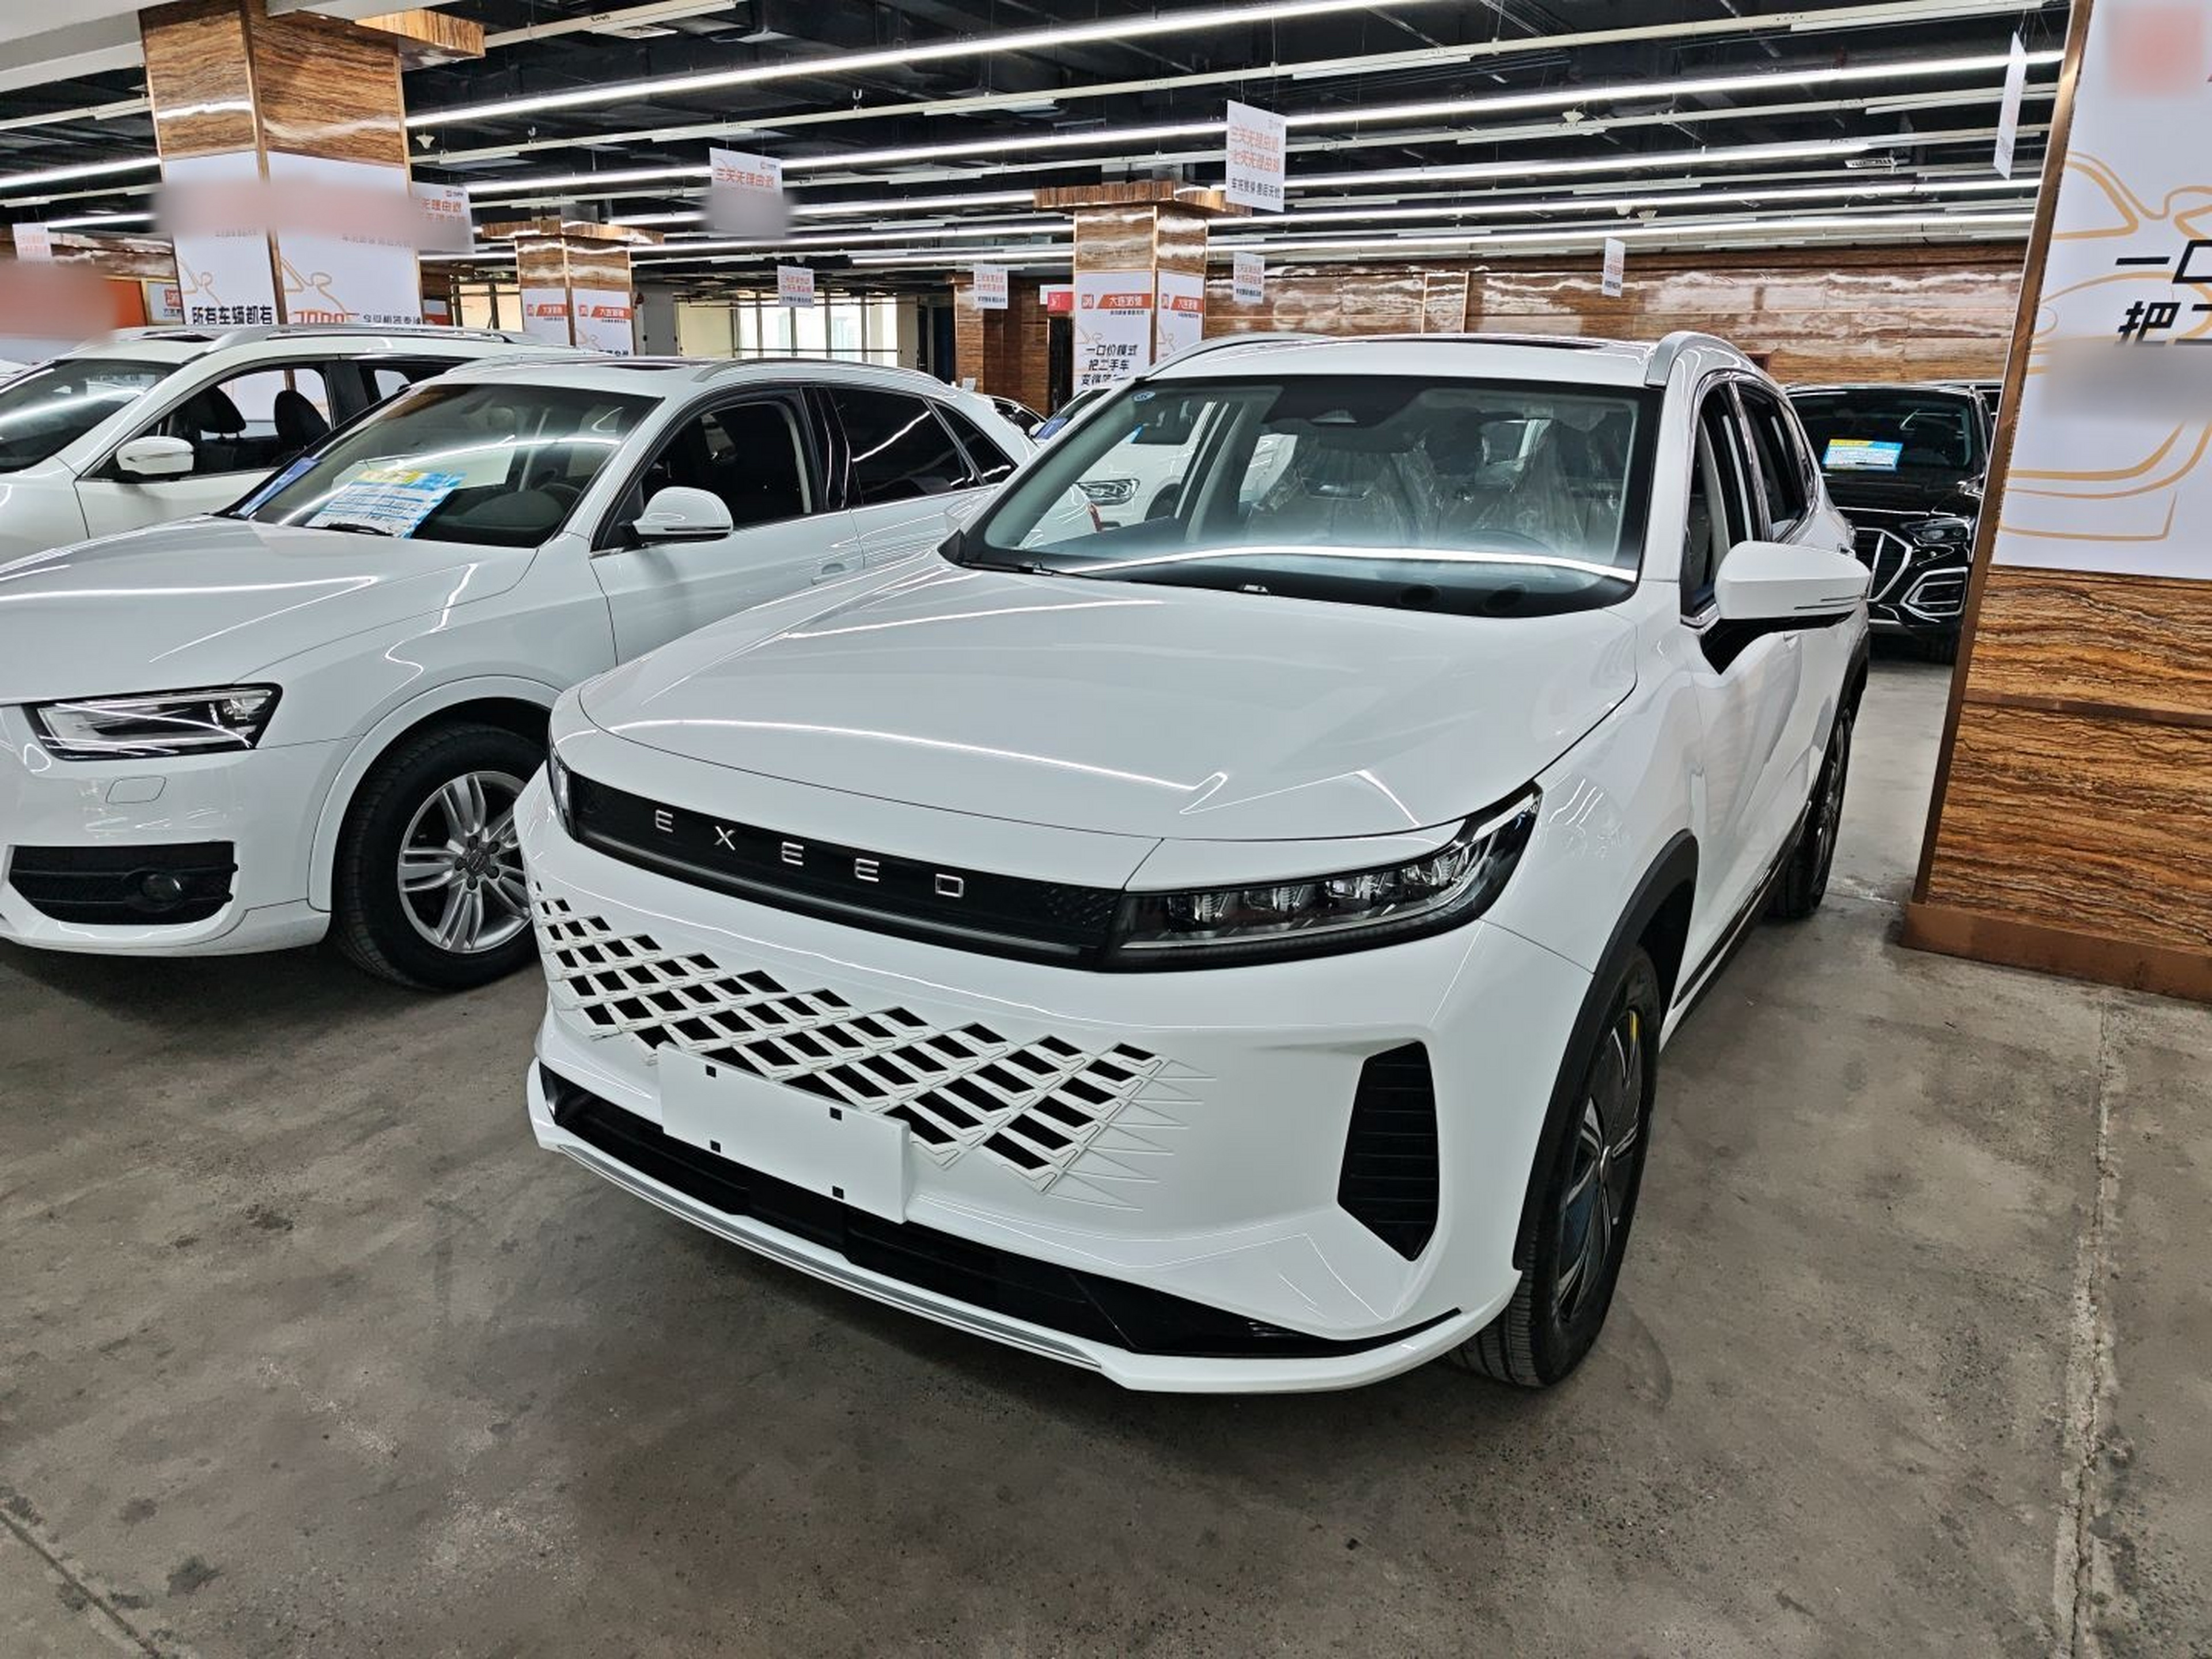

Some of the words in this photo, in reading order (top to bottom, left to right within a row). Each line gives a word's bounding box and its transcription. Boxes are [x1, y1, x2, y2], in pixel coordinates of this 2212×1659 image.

[1086, 344, 1138, 356] 一口价模式
[1088, 358, 1130, 371] 把二手车
[655, 809, 964, 898] EXEED
